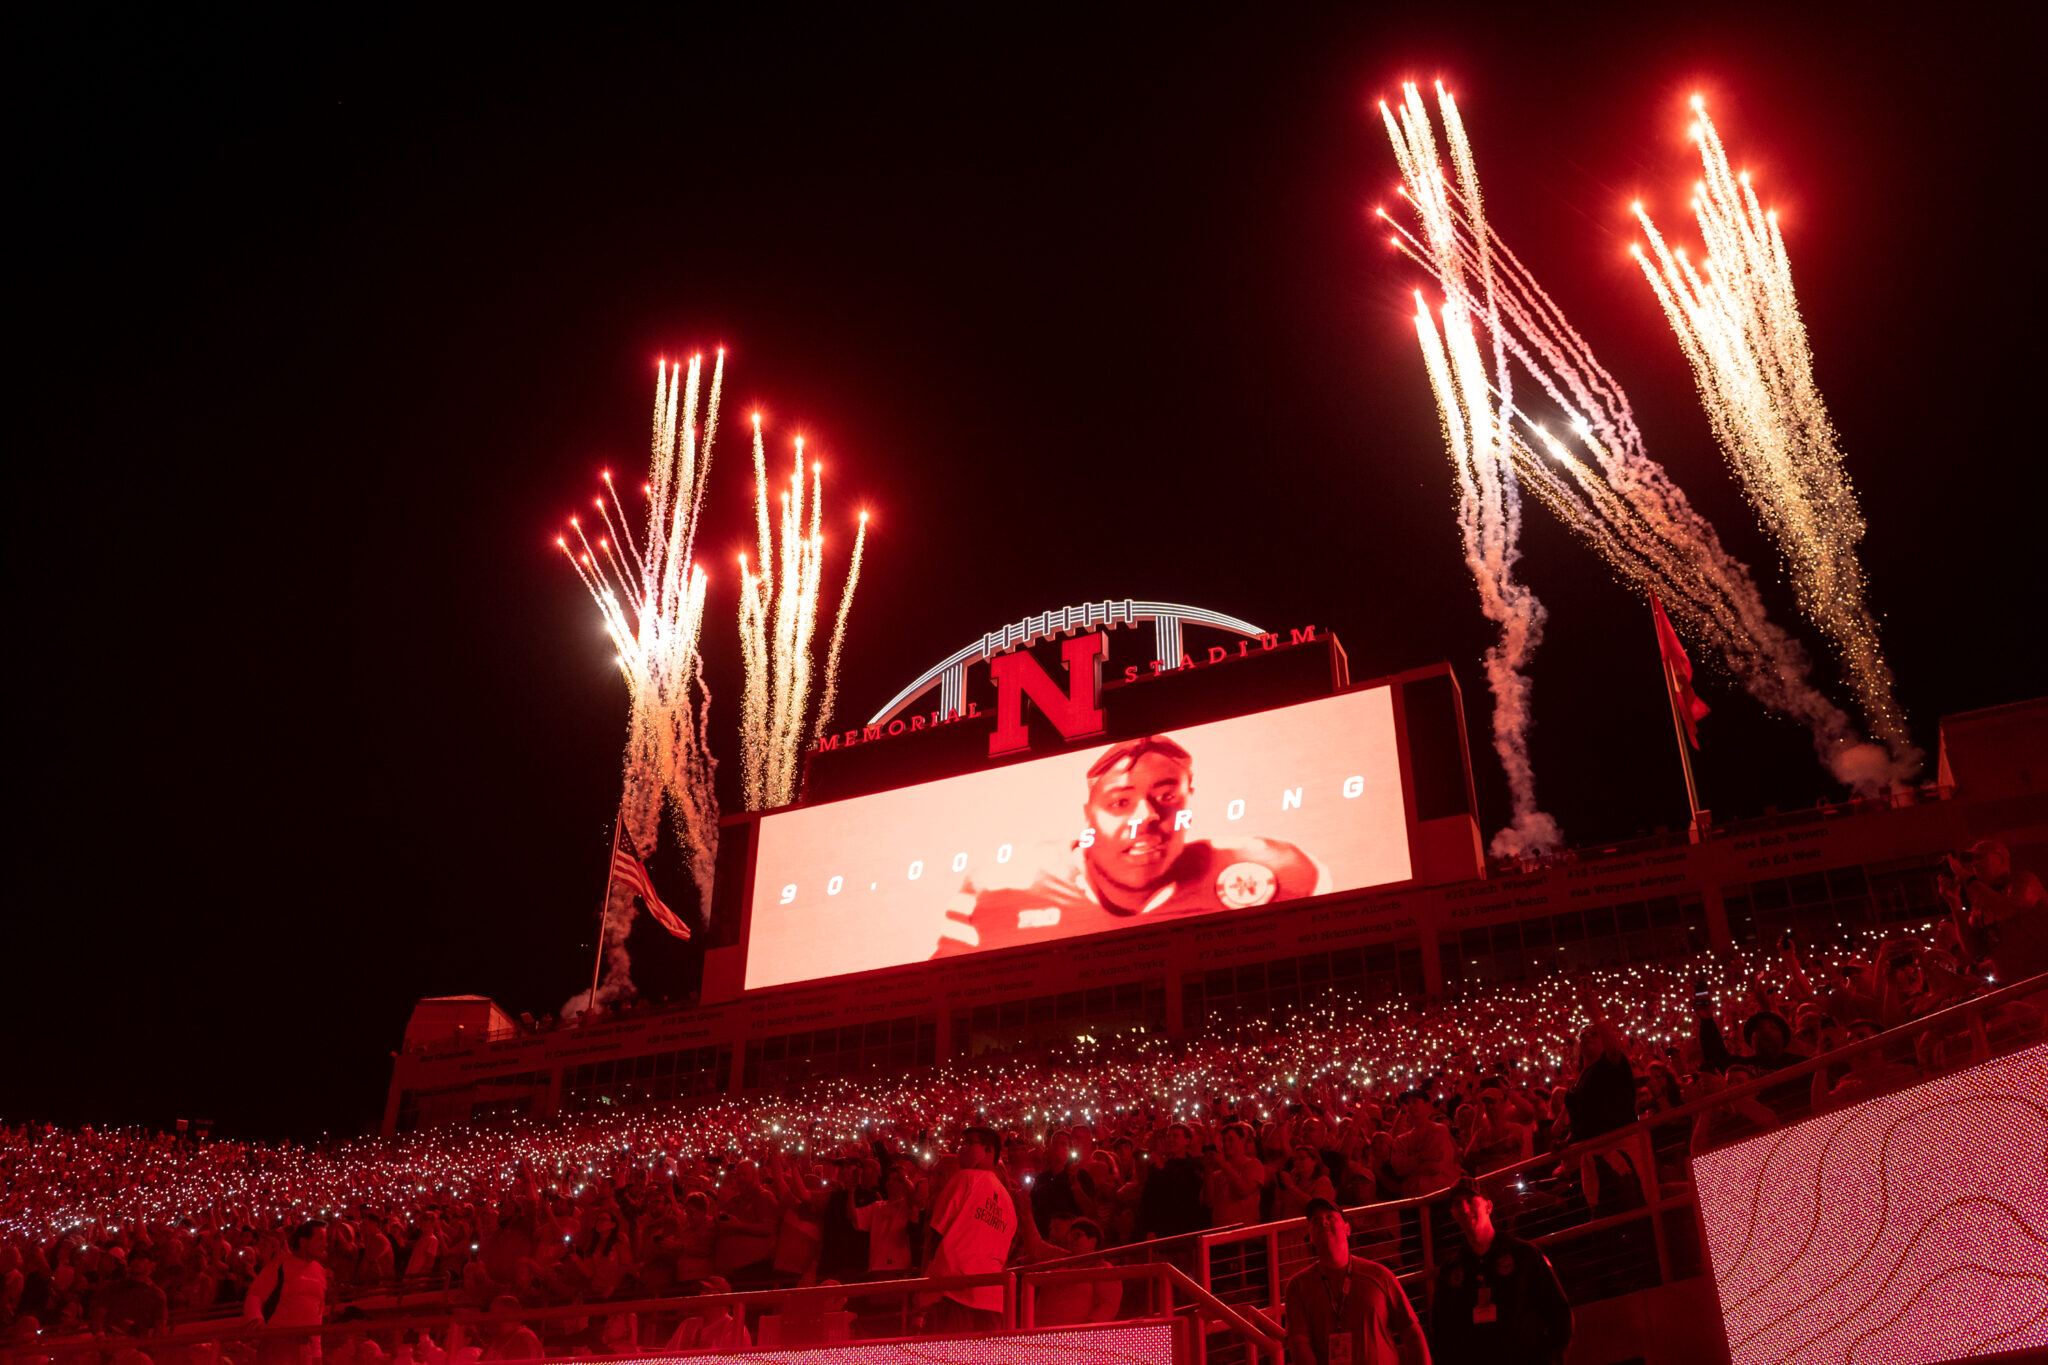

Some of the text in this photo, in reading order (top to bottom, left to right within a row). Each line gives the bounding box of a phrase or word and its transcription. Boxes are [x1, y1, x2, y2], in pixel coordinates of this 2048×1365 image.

[819, 625, 1316, 752] MEMORIAL STADIUM
[988, 631, 1108, 757] N
[780, 775, 1364, 904] 90,000 STRONG
[1787, 827, 1829, 842] Brown
[1394, 916, 1417, 929] Suh
[974, 1207, 1008, 1233] SECURITY
[985, 1197, 1003, 1217] EVENT
